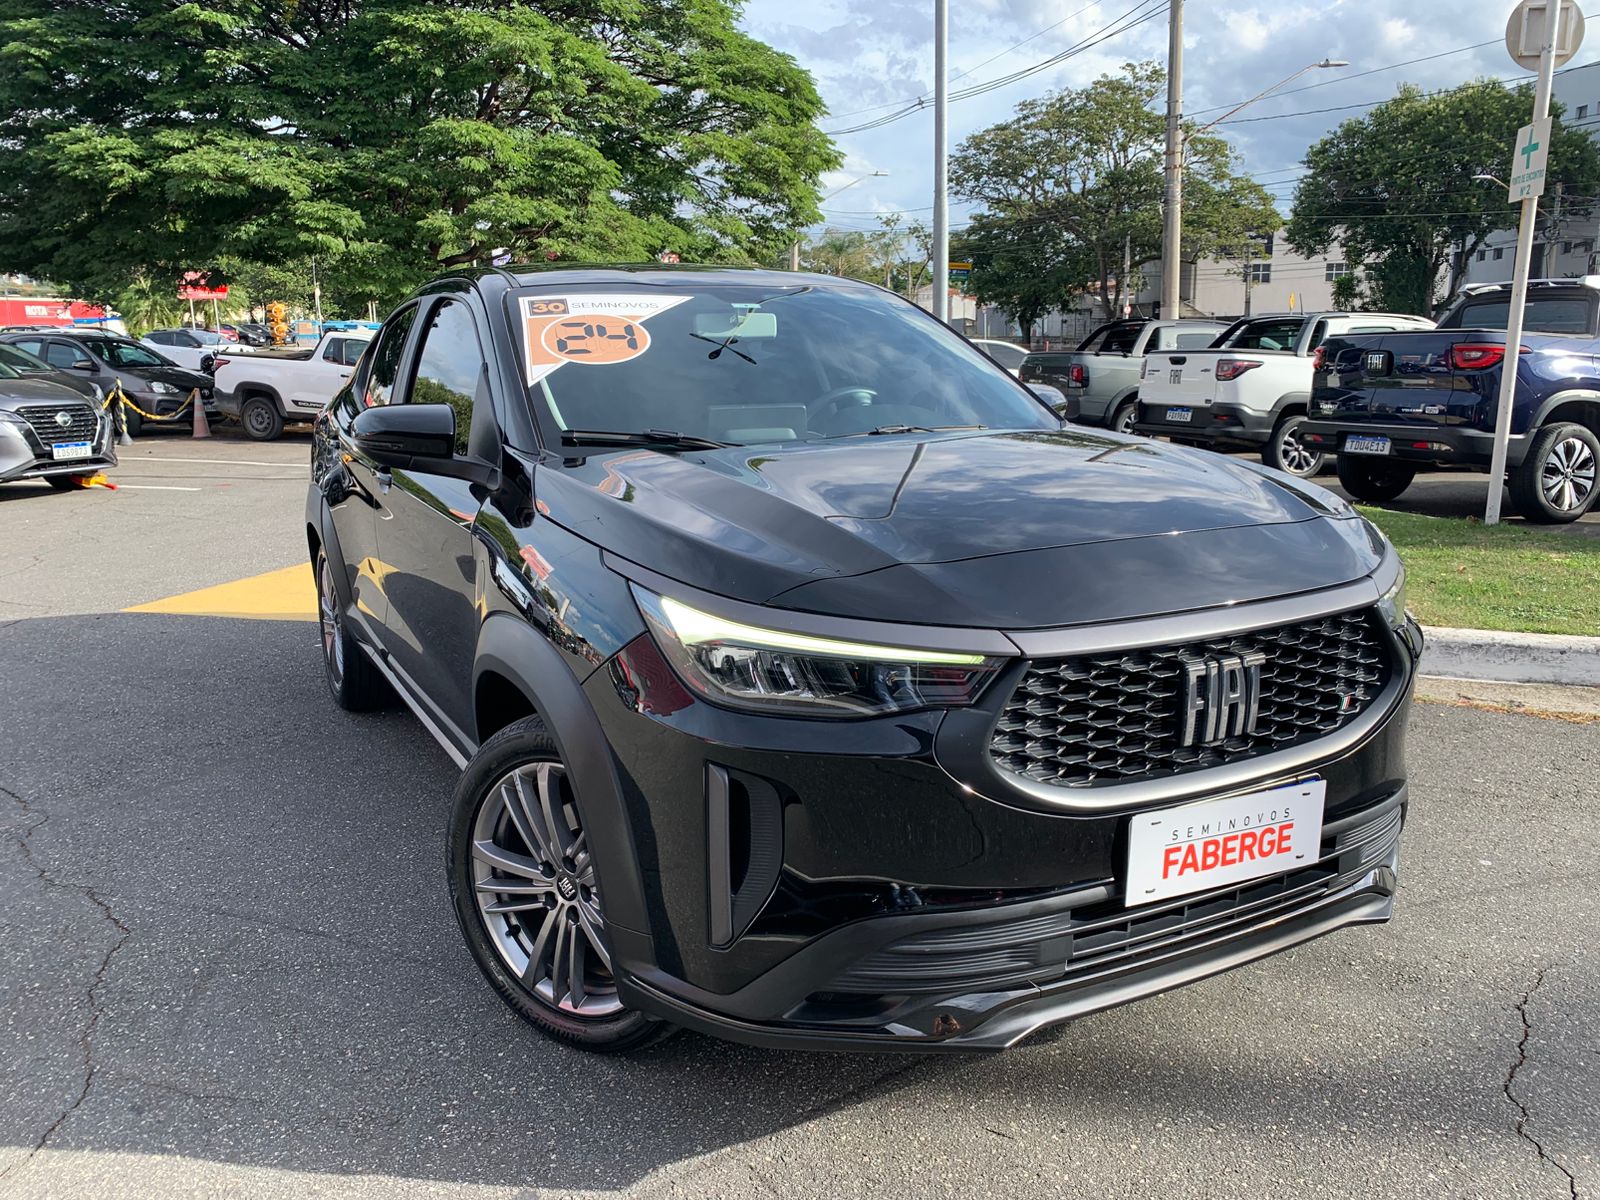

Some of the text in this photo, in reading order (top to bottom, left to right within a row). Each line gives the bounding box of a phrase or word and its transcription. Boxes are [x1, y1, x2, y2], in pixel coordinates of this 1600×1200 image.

[533, 302, 565, 313] 30
[557, 322, 639, 355] 24
[1367, 354, 1384, 369] FIAT
[1169, 369, 1183, 384] FIAT
[1348, 440, 1387, 453] TDU4E13
[1183, 652, 1267, 747] FIAT
[1171, 807, 1290, 841] SEMINOVOS
[1162, 822, 1294, 880] FABERGE
